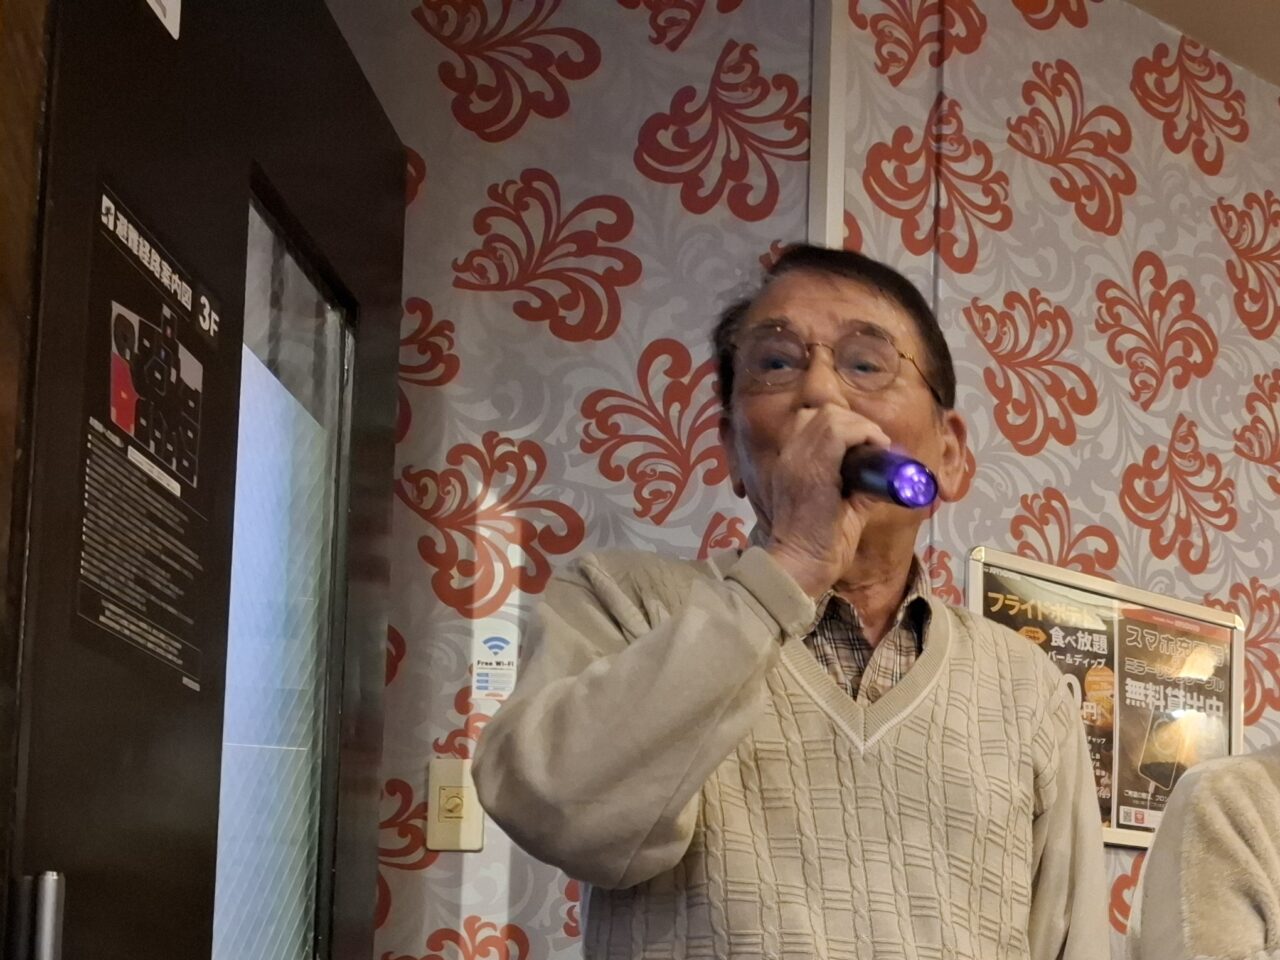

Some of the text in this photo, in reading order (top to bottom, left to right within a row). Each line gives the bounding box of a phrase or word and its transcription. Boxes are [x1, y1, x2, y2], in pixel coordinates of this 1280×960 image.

[199, 295, 220, 337] 3F
[1049, 626, 1108, 655] 食べ放題
[1125, 677, 1224, 718] 無料貸出中
